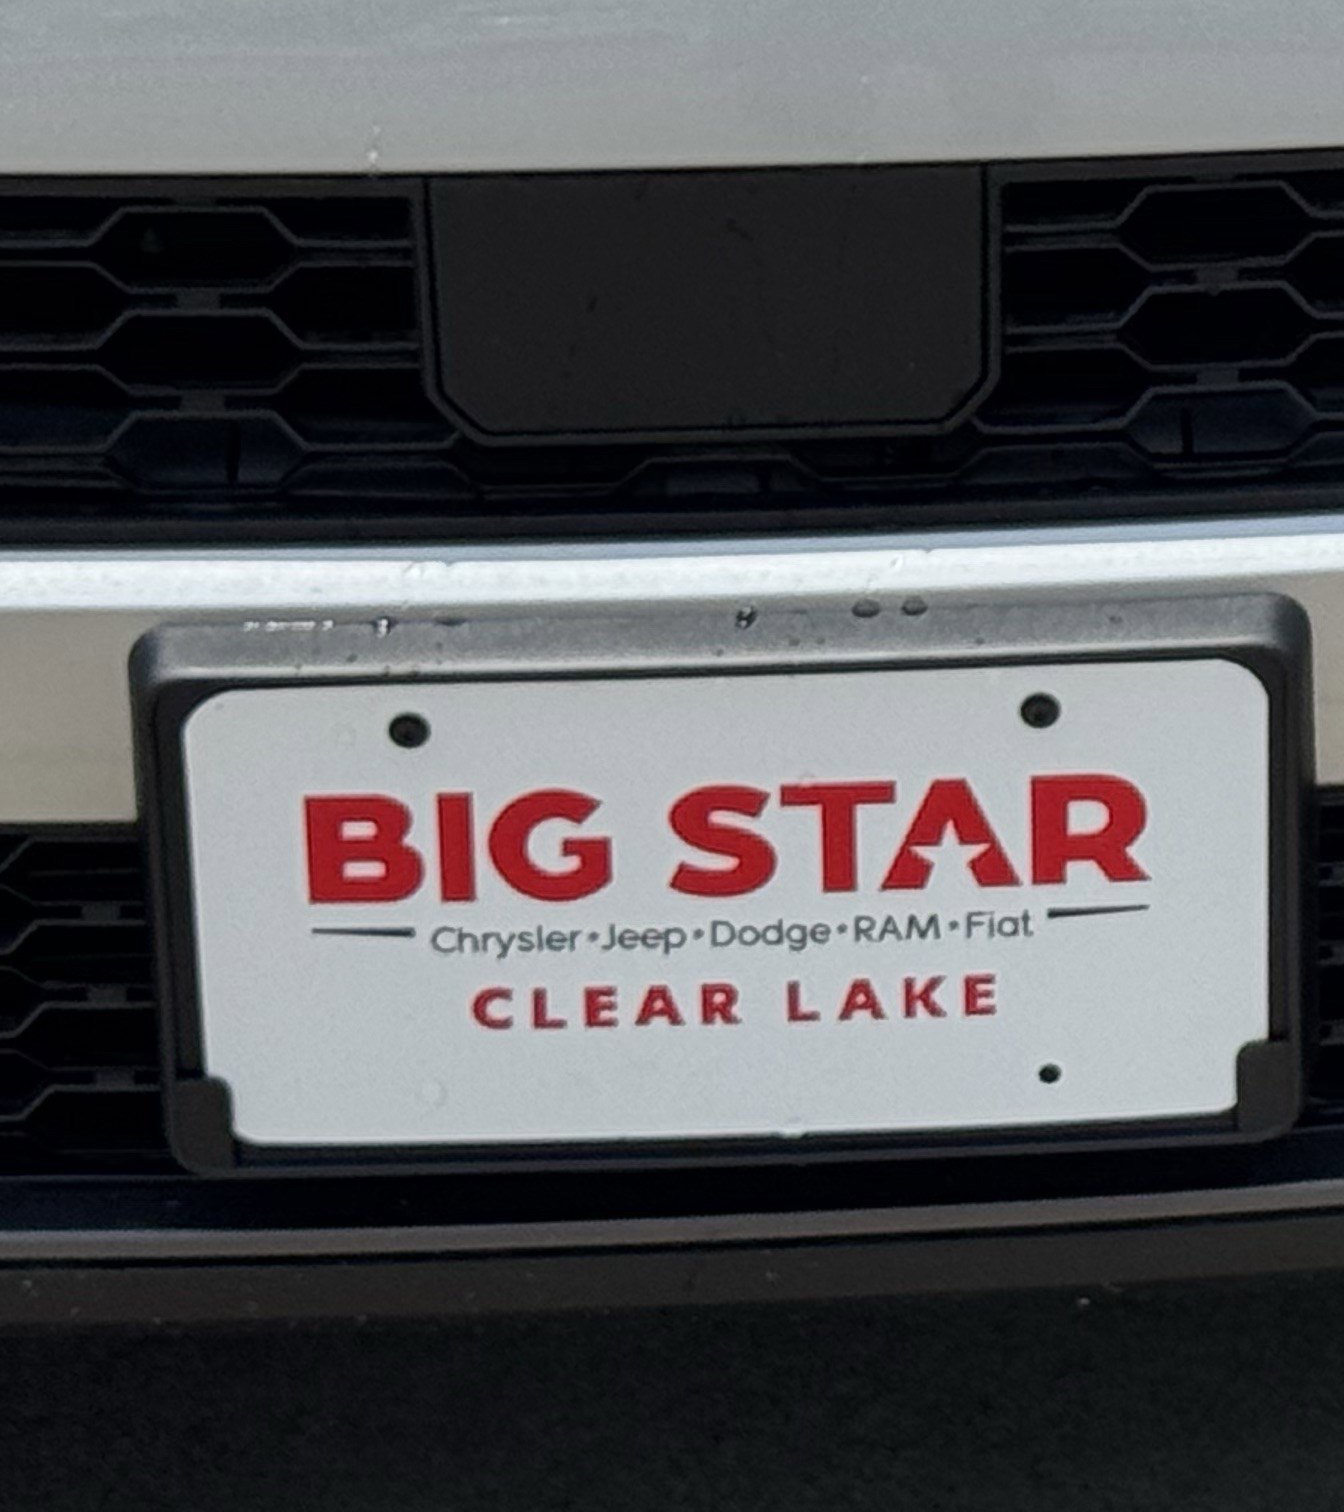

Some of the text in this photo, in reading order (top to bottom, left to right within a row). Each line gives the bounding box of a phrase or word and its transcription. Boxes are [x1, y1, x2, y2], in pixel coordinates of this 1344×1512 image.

[302, 773, 1150, 904] BIG STAR
[470, 973, 997, 1030] CLEAR LAKE
